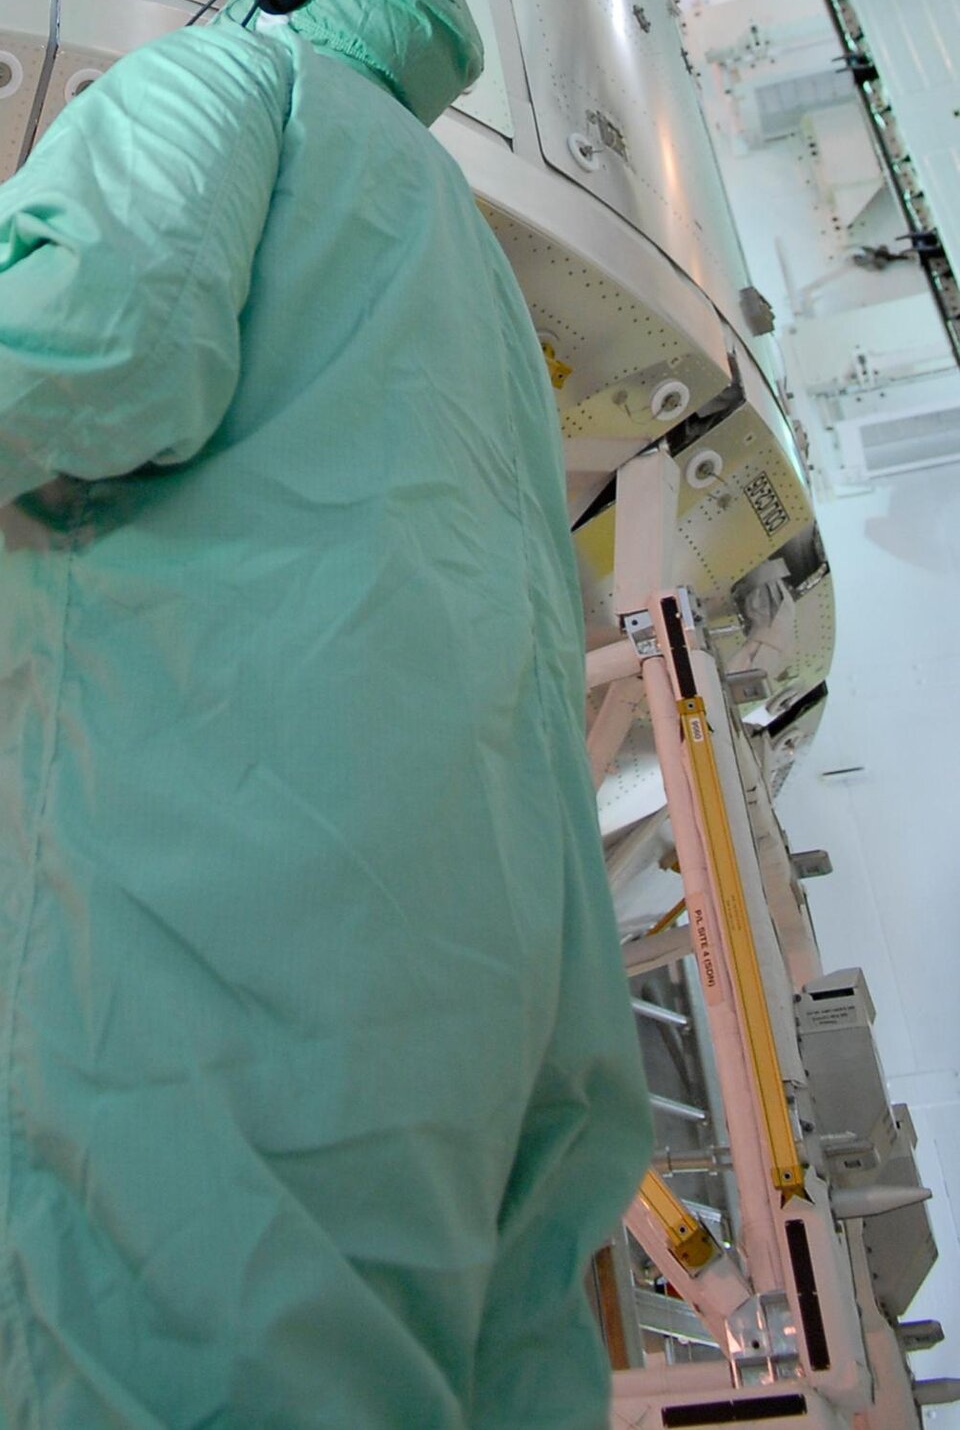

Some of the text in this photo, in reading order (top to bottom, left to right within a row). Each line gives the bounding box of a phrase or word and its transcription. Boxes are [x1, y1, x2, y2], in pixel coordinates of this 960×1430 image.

[746, 475, 787, 533] COL/C2-05
[695, 909, 704, 925] P/L
[698, 927, 709, 949] SITE
